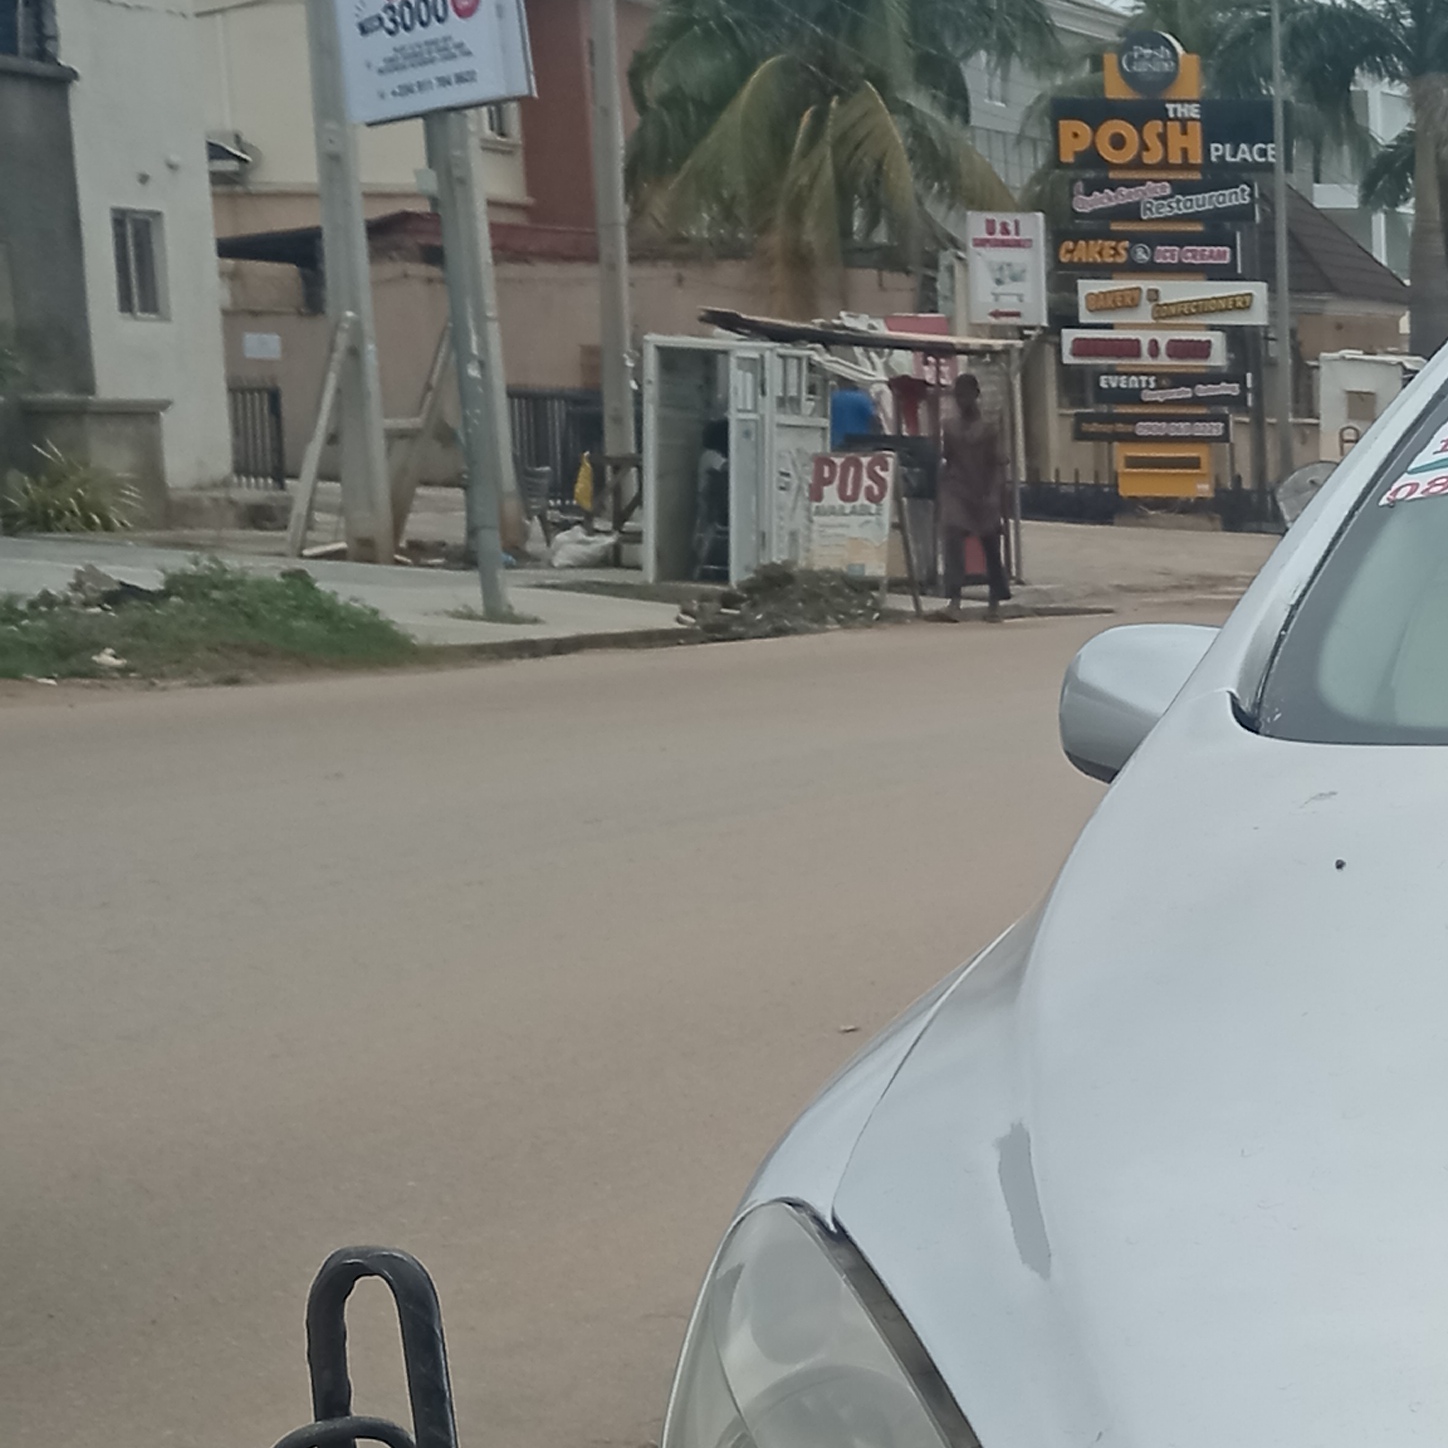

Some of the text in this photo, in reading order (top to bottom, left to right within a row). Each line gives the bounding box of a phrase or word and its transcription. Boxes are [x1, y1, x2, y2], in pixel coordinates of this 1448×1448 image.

[1132, 45, 1172, 60] Posh
[1165, 103, 1201, 119] THE
[1058, 119, 1203, 164] POSH
[1209, 143, 1277, 163] PLACE
[1140, 183, 1251, 220] Restaurant
[985, 218, 996, 236] U
[999, 221, 1011, 236] &
[1058, 239, 1129, 264] CAKES
[1154, 246, 1179, 264] ICE
[1181, 246, 1231, 264] CREAM
[1085, 287, 1142, 313] BAKERY
[1151, 292, 1254, 321] CONFECTIONERY
[1099, 375, 1156, 389] EVENTS
[809, 453, 890, 503] POS
